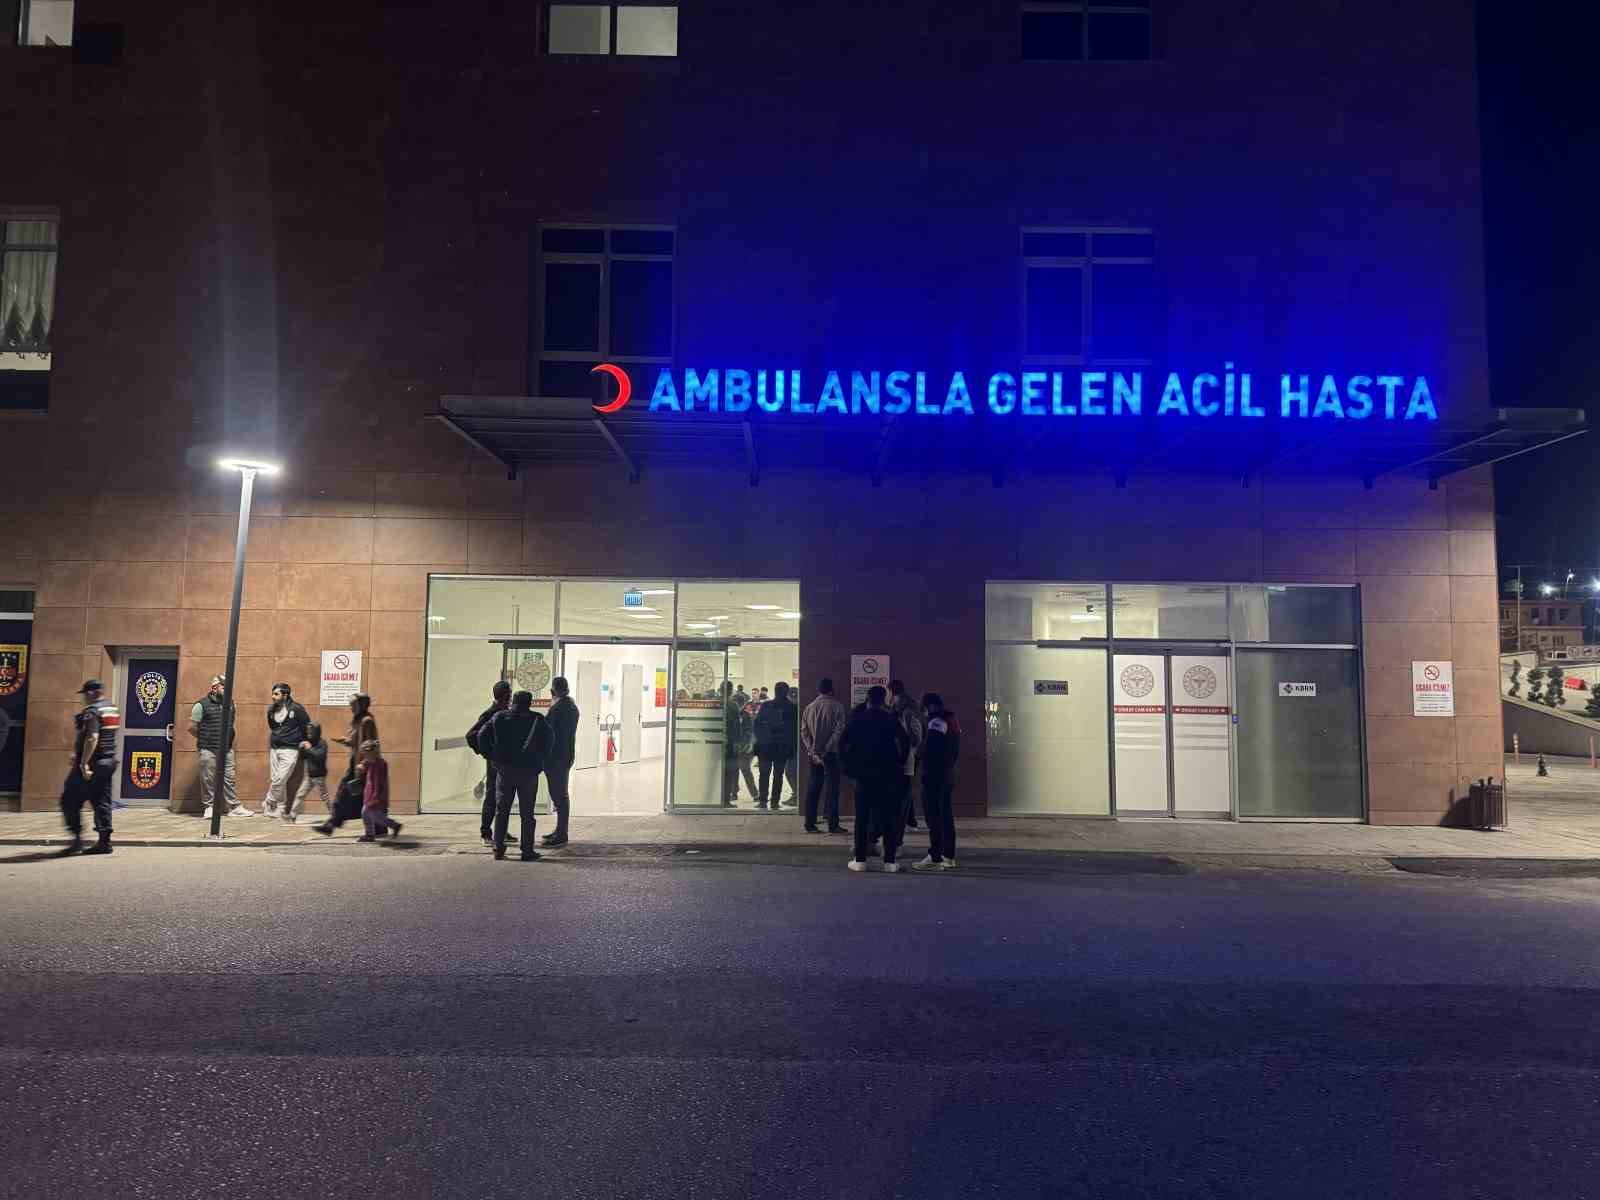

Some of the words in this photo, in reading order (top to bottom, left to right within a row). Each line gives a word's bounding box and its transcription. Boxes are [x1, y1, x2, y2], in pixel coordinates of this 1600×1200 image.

[649, 367, 974, 416] AMBULANSLA
[987, 371, 1142, 417] GELEN
[1157, 361, 1265, 417] ACİL
[1280, 374, 1438, 420] HASTA
[1295, 685, 1314, 693] KBRN
